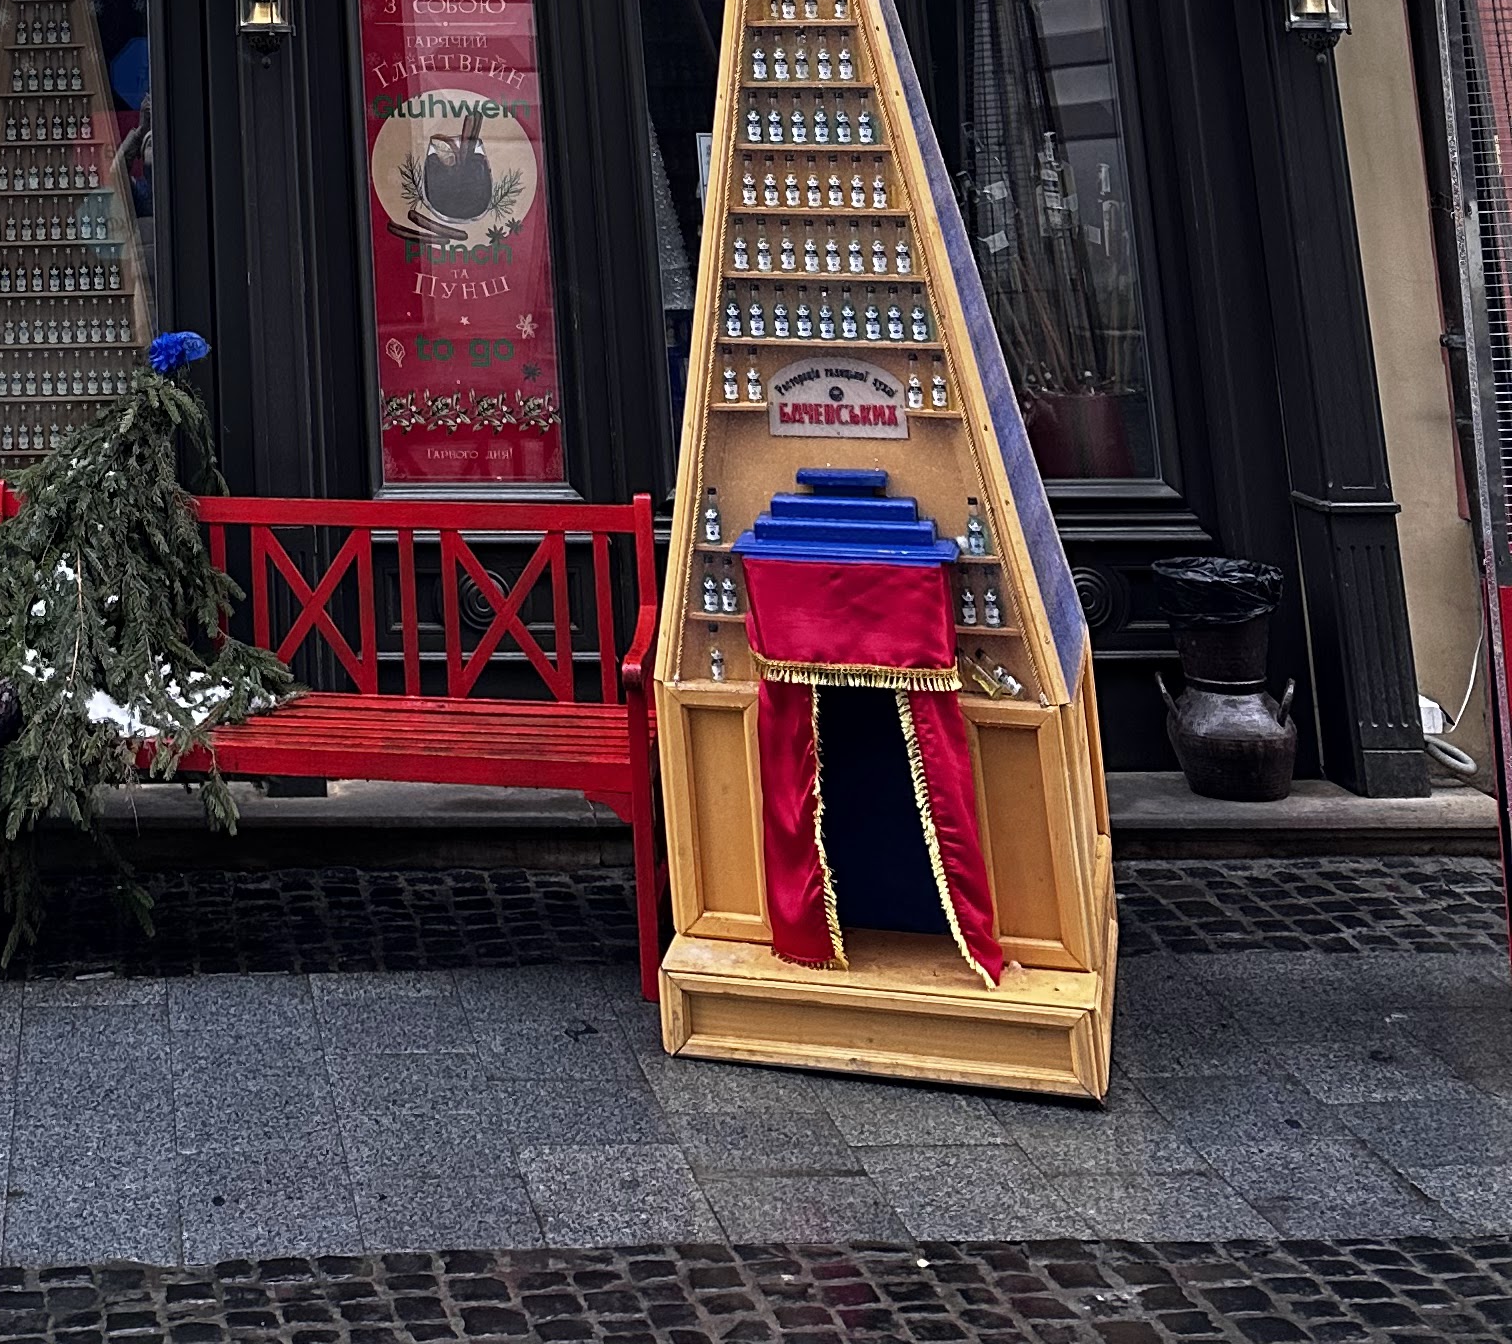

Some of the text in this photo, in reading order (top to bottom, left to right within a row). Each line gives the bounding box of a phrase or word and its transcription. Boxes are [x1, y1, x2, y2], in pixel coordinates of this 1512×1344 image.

[406, 32, 488, 49] ГАРЯЧИЙ
[372, 92, 532, 120] Glühwein
[405, 239, 513, 264] Punch
[412, 272, 511, 300] ПУНШ
[414, 333, 515, 368] to go
[778, 401, 899, 427] БАЧЕВСЬКИХ
